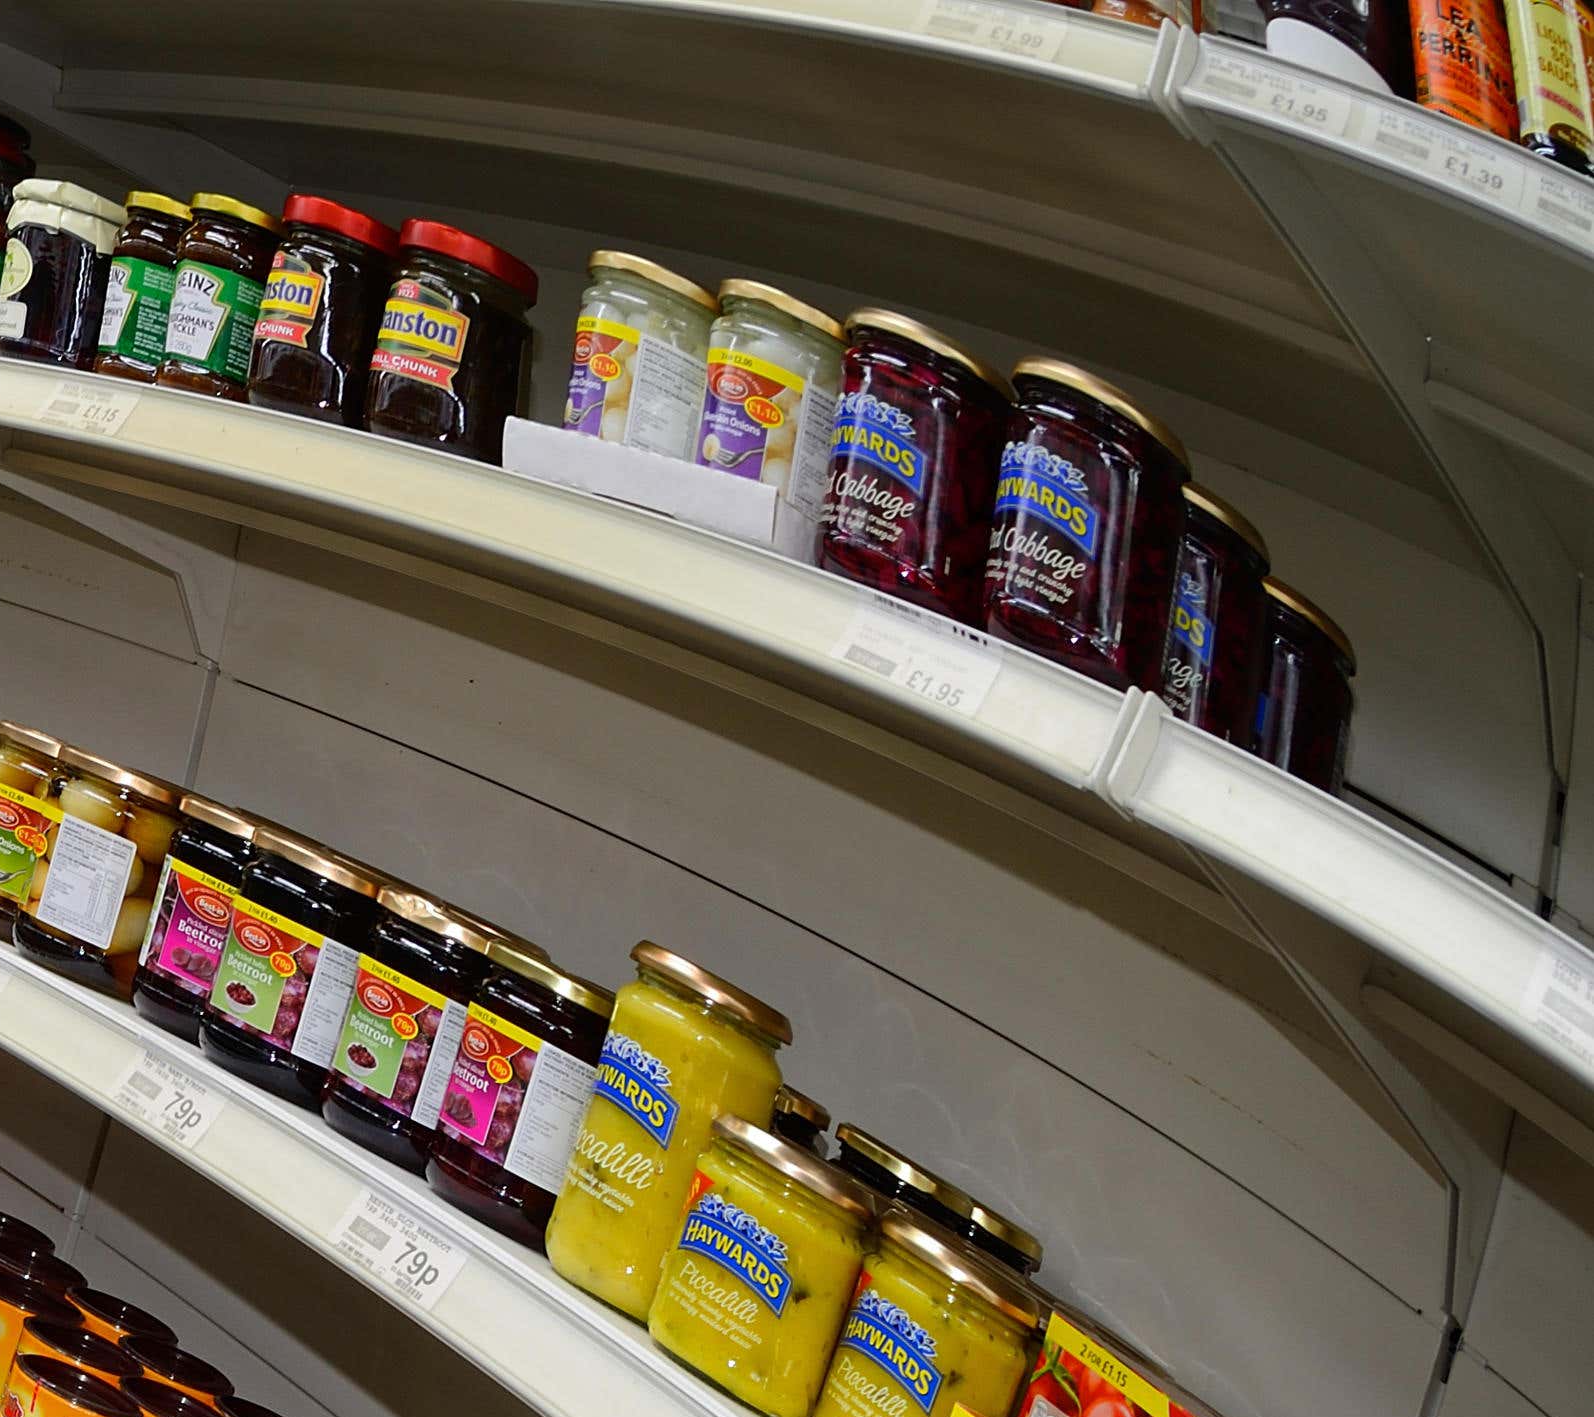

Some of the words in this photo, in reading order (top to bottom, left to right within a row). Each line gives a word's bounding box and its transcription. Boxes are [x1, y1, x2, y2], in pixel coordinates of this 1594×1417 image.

[1434, 2, 1482, 36] LEA
[990, 27, 1044, 49] £1.99
[1270, 94, 1328, 123] £1.95
[1444, 157, 1504, 191] £1.39
[259, 324, 294, 337] CHUNK
[391, 355, 438, 378] CHUNK
[83, 407, 116, 424] £1.15
[729, 412, 762, 438] Onions
[749, 402, 781, 422] £1.15
[837, 471, 915, 518] Cabbage
[1002, 527, 1087, 583] Cabbage
[906, 670, 963, 708] £1.95
[226, 954, 273, 986] Beetroot
[349, 1012, 395, 1048] Beetroot
[164, 1091, 201, 1128] 79p
[394, 1241, 440, 1287] 79p
[686, 1219, 782, 1299] HAYWARDS
[680, 1260, 757, 1325] Piccalilli
[847, 1315, 932, 1397] HAYWARDS
[1079, 1343, 1087, 1356] 2
[1088, 1351, 1101, 1366] FOR
[1102, 1359, 1127, 1387] £1.15
